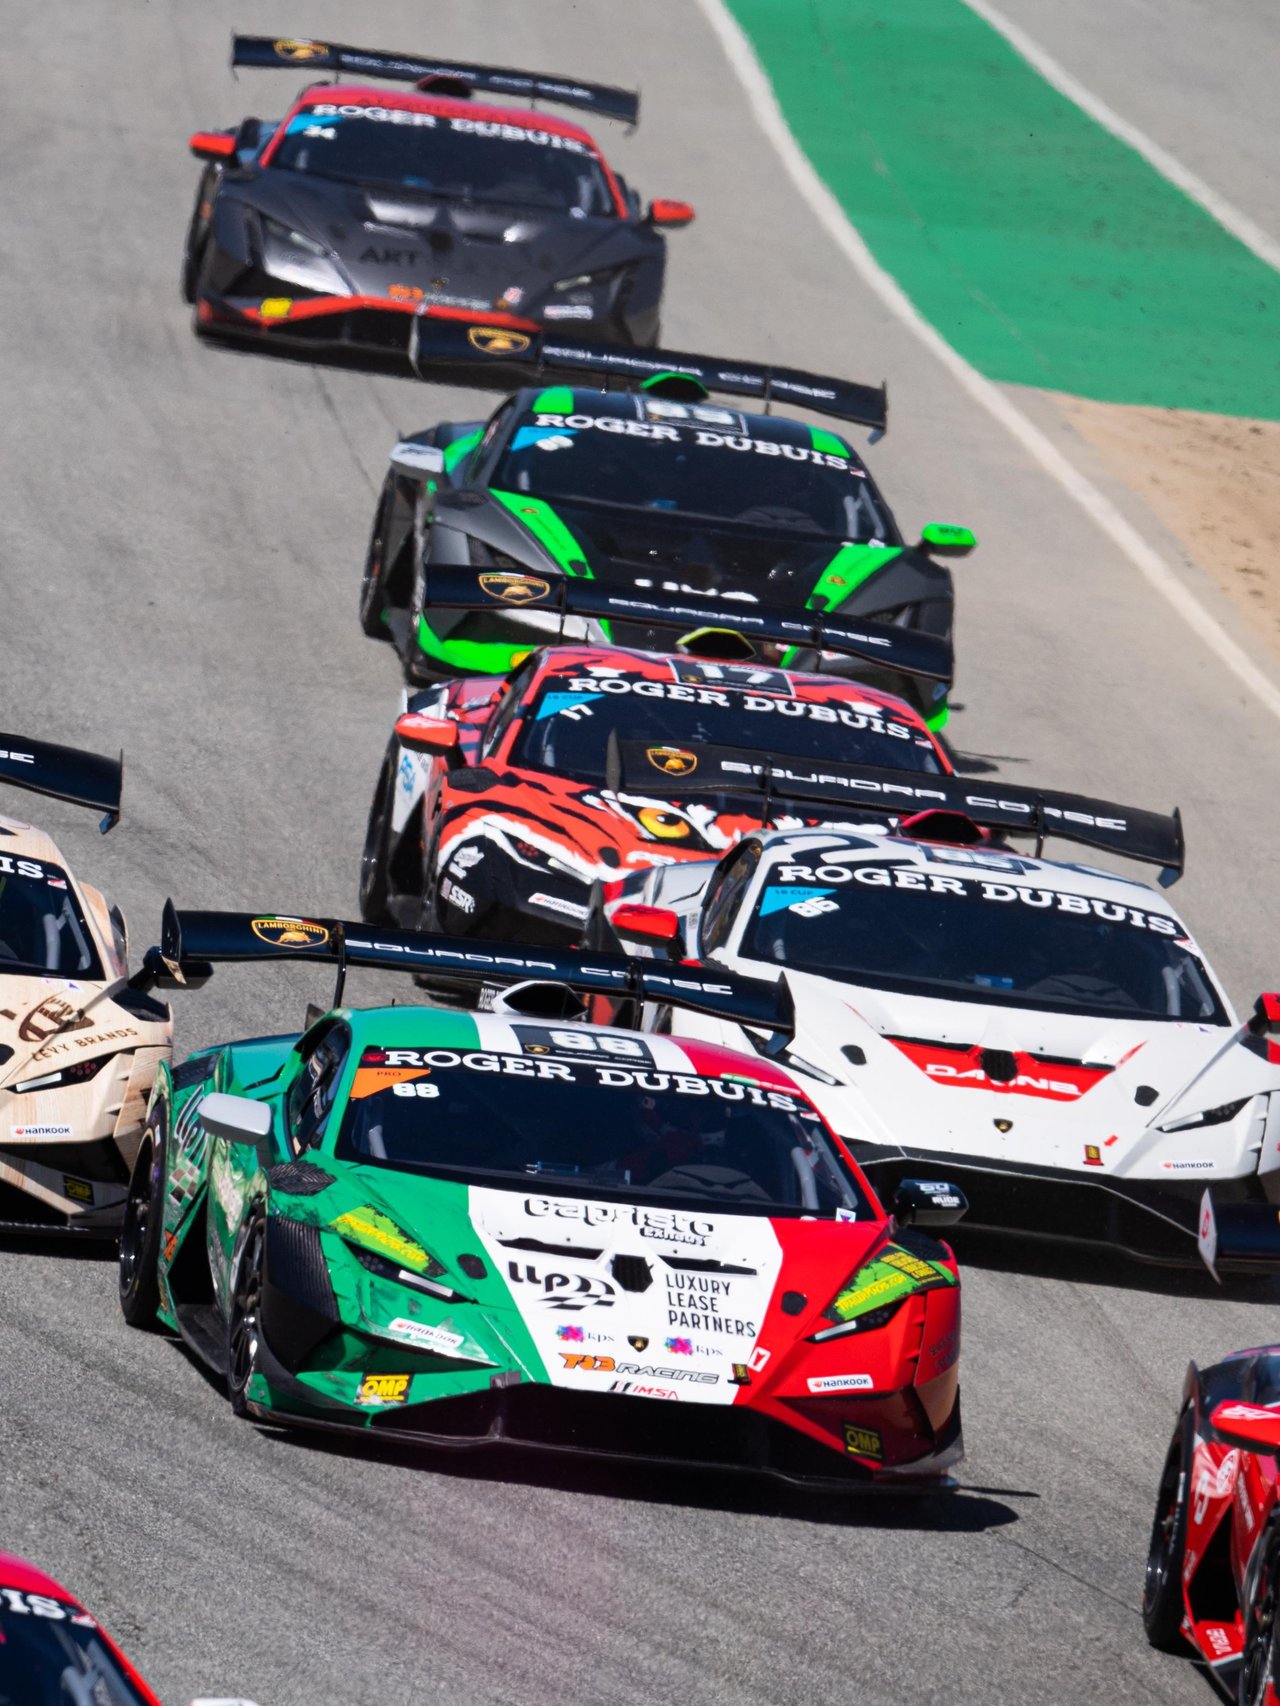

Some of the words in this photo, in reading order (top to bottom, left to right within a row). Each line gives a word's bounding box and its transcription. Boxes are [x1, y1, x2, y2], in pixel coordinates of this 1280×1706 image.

[312, 104, 439, 128] ROGER
[451, 119, 588, 154] DUBUIS
[535, 414, 681, 442] ROGER
[696, 431, 849, 472] DUBUIS
[608, 597, 764, 626] SQUADRA
[568, 677, 730, 709] ROGER
[743, 696, 912, 741] DUBUIS
[720, 760, 948, 802] SQUADRA
[965, 795, 1128, 832] CORSE
[778, 865, 968, 896] ROGER
[981, 882, 1178, 936] DUBUIS
[788, 896, 841, 919] 86
[345, 938, 557, 971] SQUADRA
[580, 966, 733, 996] CORSE
[31, 1043, 70, 1063] LEVY
[74, 1027, 139, 1049] BRANDS
[548, 1030, 645, 1058] 88
[385, 1050, 576, 1083] ROGER
[595, 1068, 800, 1113] DUBUIS
[392, 1082, 440, 1099] 88
[665, 1273, 732, 1297] LUXURY
[668, 1291, 720, 1314] LEASE
[668, 1309, 758, 1339] PARTNERS
[615, 1362, 721, 1386] RACING
[361, 1379, 410, 1399] OMP
[846, 1430, 881, 1451] OMP
